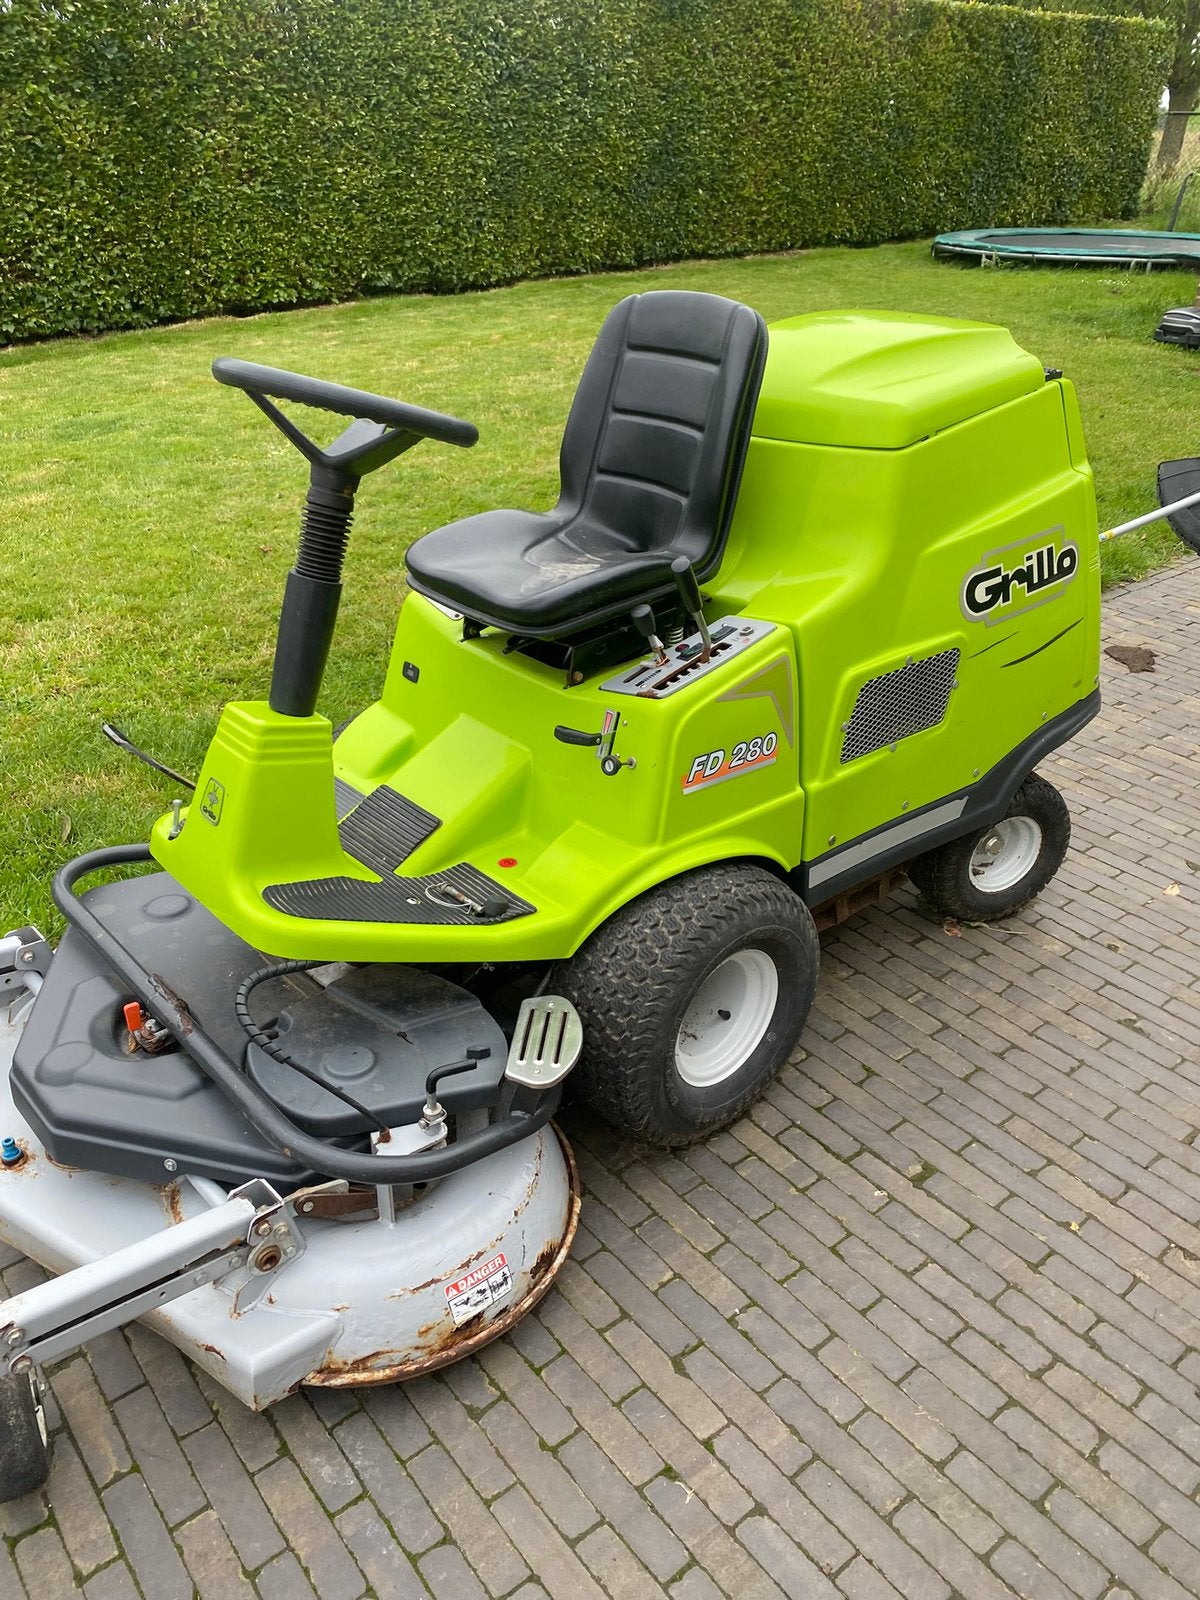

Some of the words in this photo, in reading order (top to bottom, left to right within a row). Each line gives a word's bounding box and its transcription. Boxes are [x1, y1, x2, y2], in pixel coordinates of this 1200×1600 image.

[965, 544, 1077, 615] Grillo
[686, 749, 725, 784] FD
[728, 731, 778, 769] 280
[457, 1257, 503, 1291] DANGER
